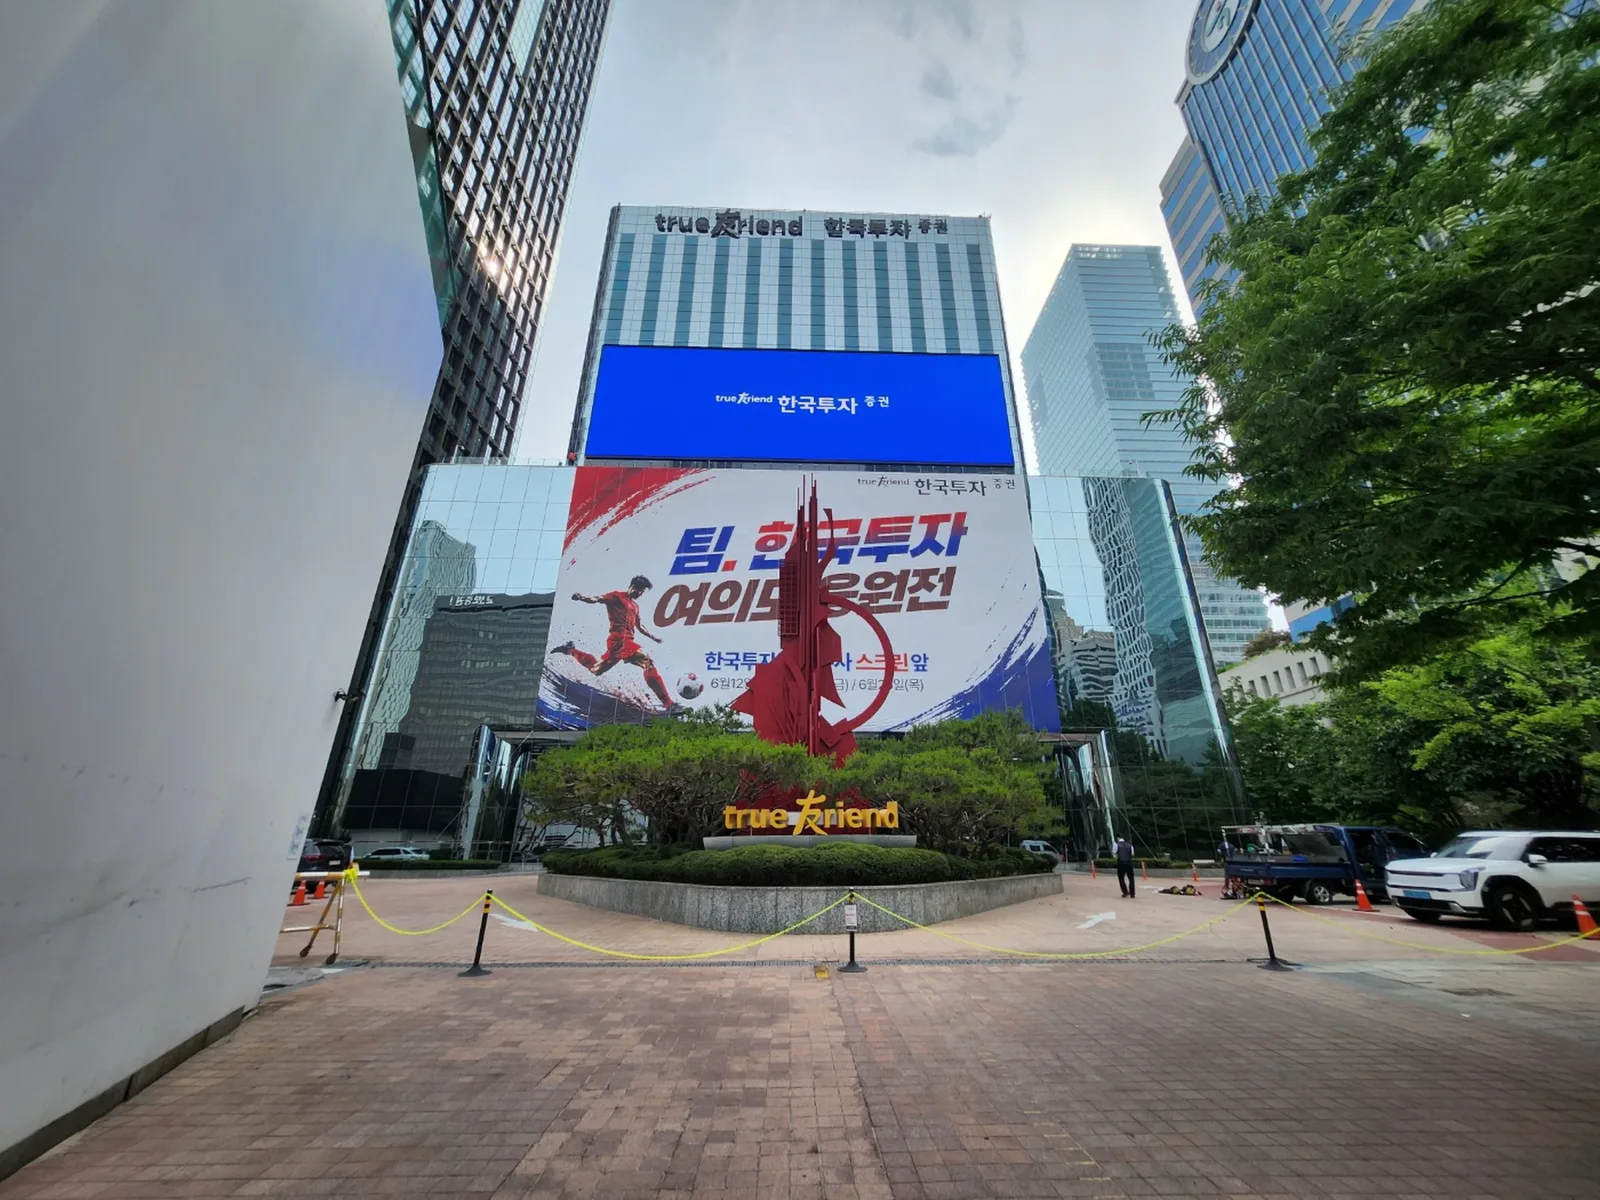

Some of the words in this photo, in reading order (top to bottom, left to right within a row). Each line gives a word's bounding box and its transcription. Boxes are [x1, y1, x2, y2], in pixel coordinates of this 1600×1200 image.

[824, 217, 911, 239] 한국투자
[918, 219, 948, 235] 증권
[777, 395, 858, 415] 한국투자
[864, 395, 890, 408] 증권
[915, 478, 987, 497] 한국투자
[993, 478, 1016, 490] 증권
[669, 525, 738, 575] 팀.
[749, 511, 968, 571] 한국투자
